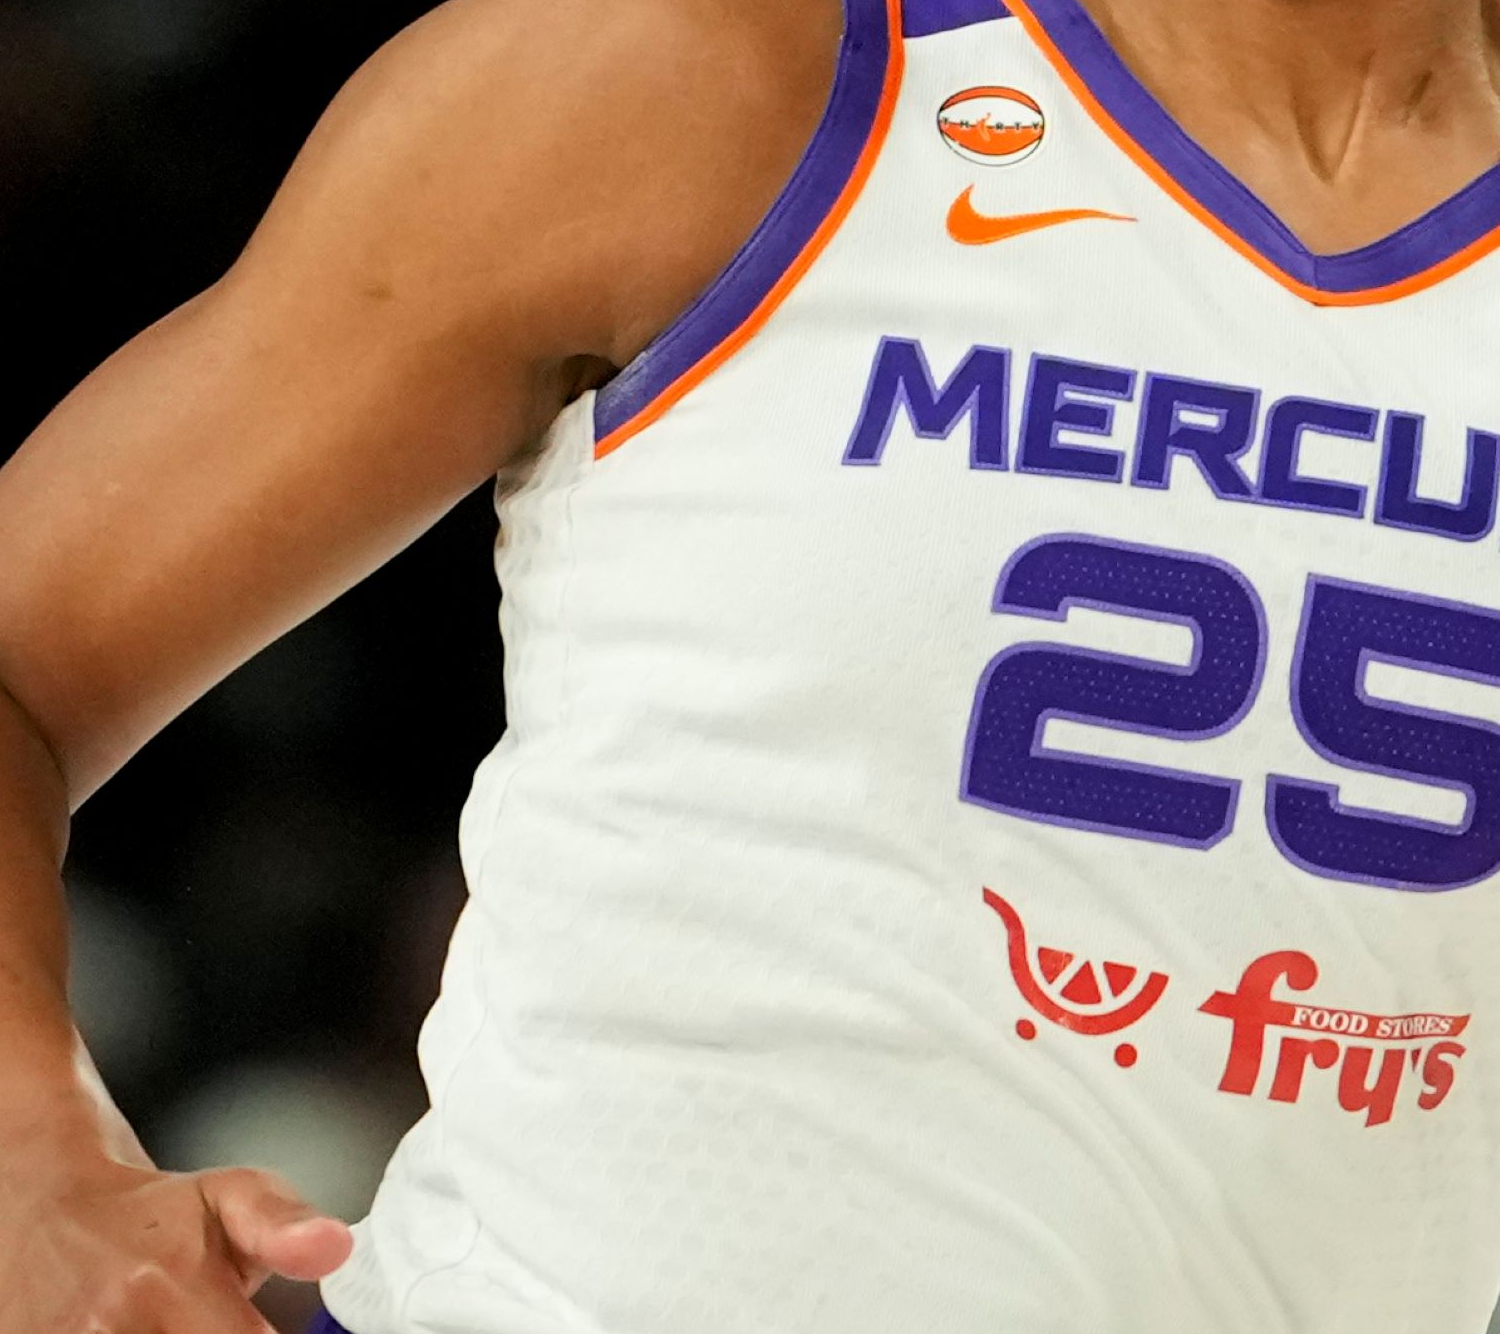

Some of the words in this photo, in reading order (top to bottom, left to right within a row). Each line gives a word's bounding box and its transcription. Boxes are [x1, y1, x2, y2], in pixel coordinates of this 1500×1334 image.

[1197, 950, 1469, 1128] fry's
[1291, 1006, 1369, 1035] FOOD
[1374, 1014, 1454, 1038] STORES
